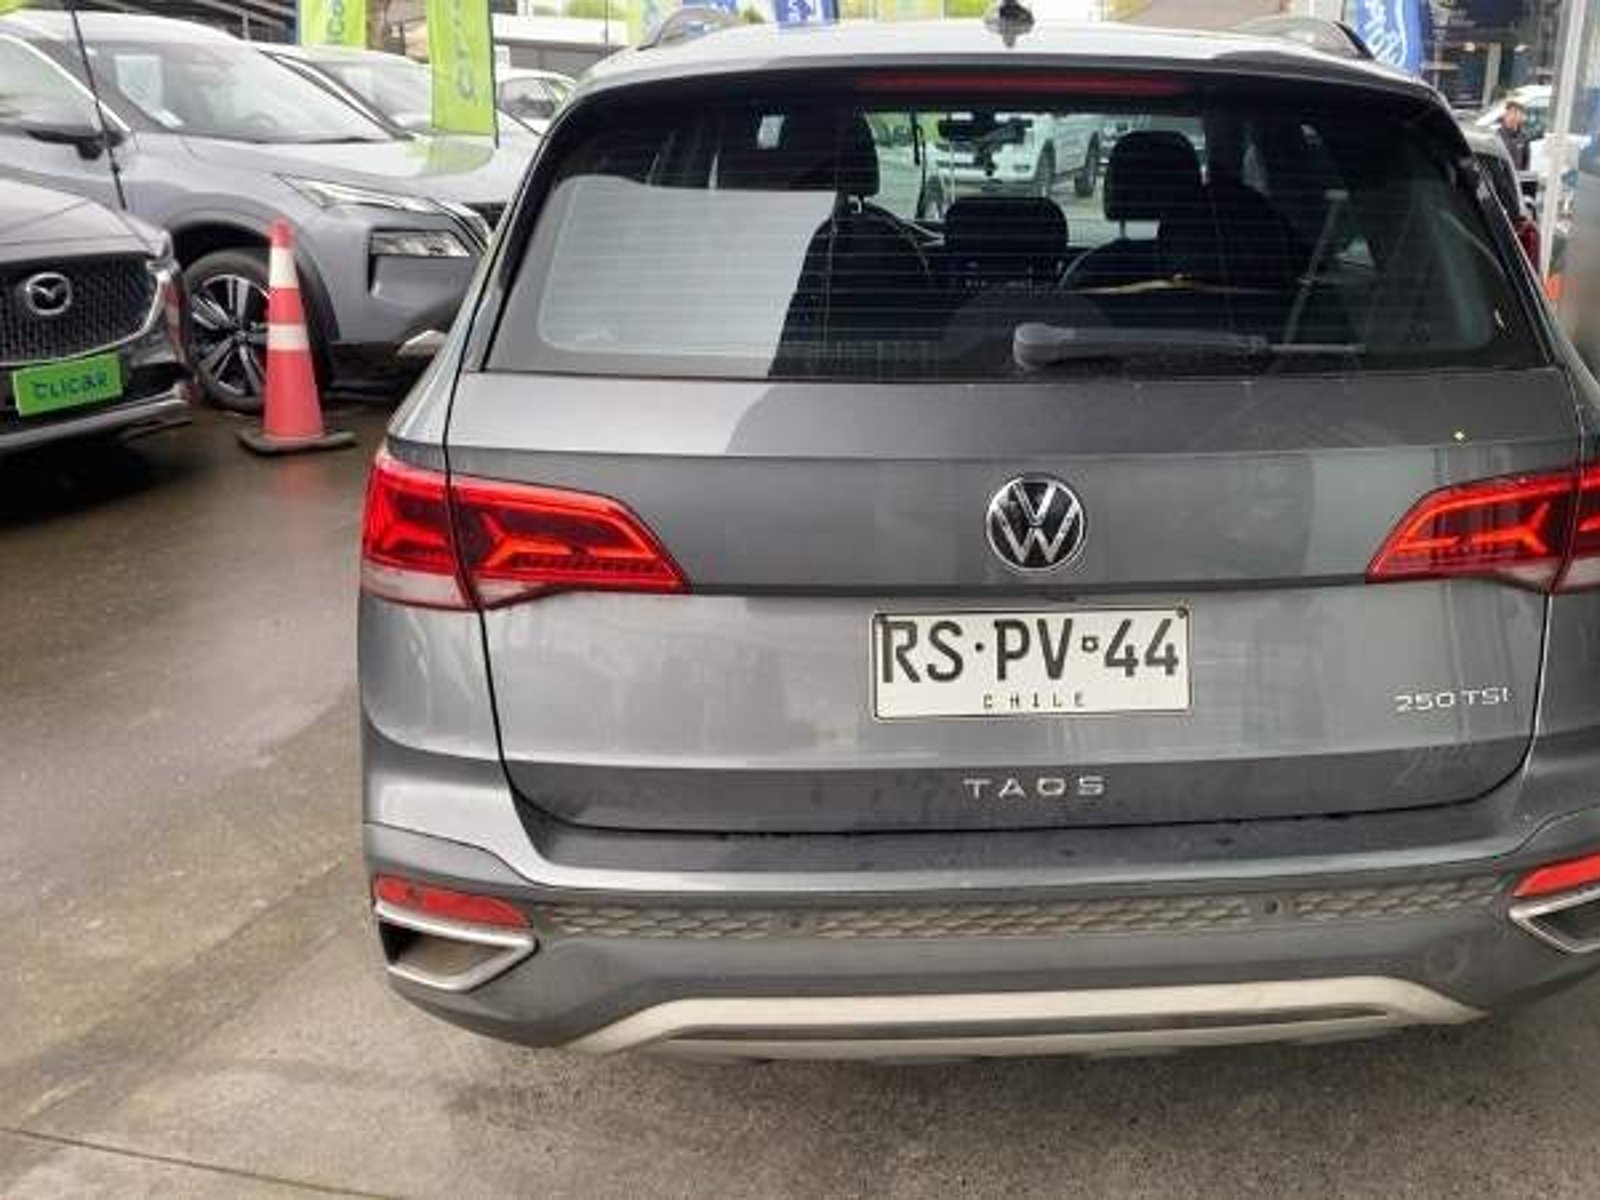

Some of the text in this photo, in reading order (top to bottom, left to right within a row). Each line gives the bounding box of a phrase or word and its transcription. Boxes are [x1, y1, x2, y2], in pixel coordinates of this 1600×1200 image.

[988, 478, 1083, 568] VW
[982, 692, 1086, 709] CHILE
[1395, 687, 1508, 711] 250 TSI
[963, 775, 1104, 799] TAOS
